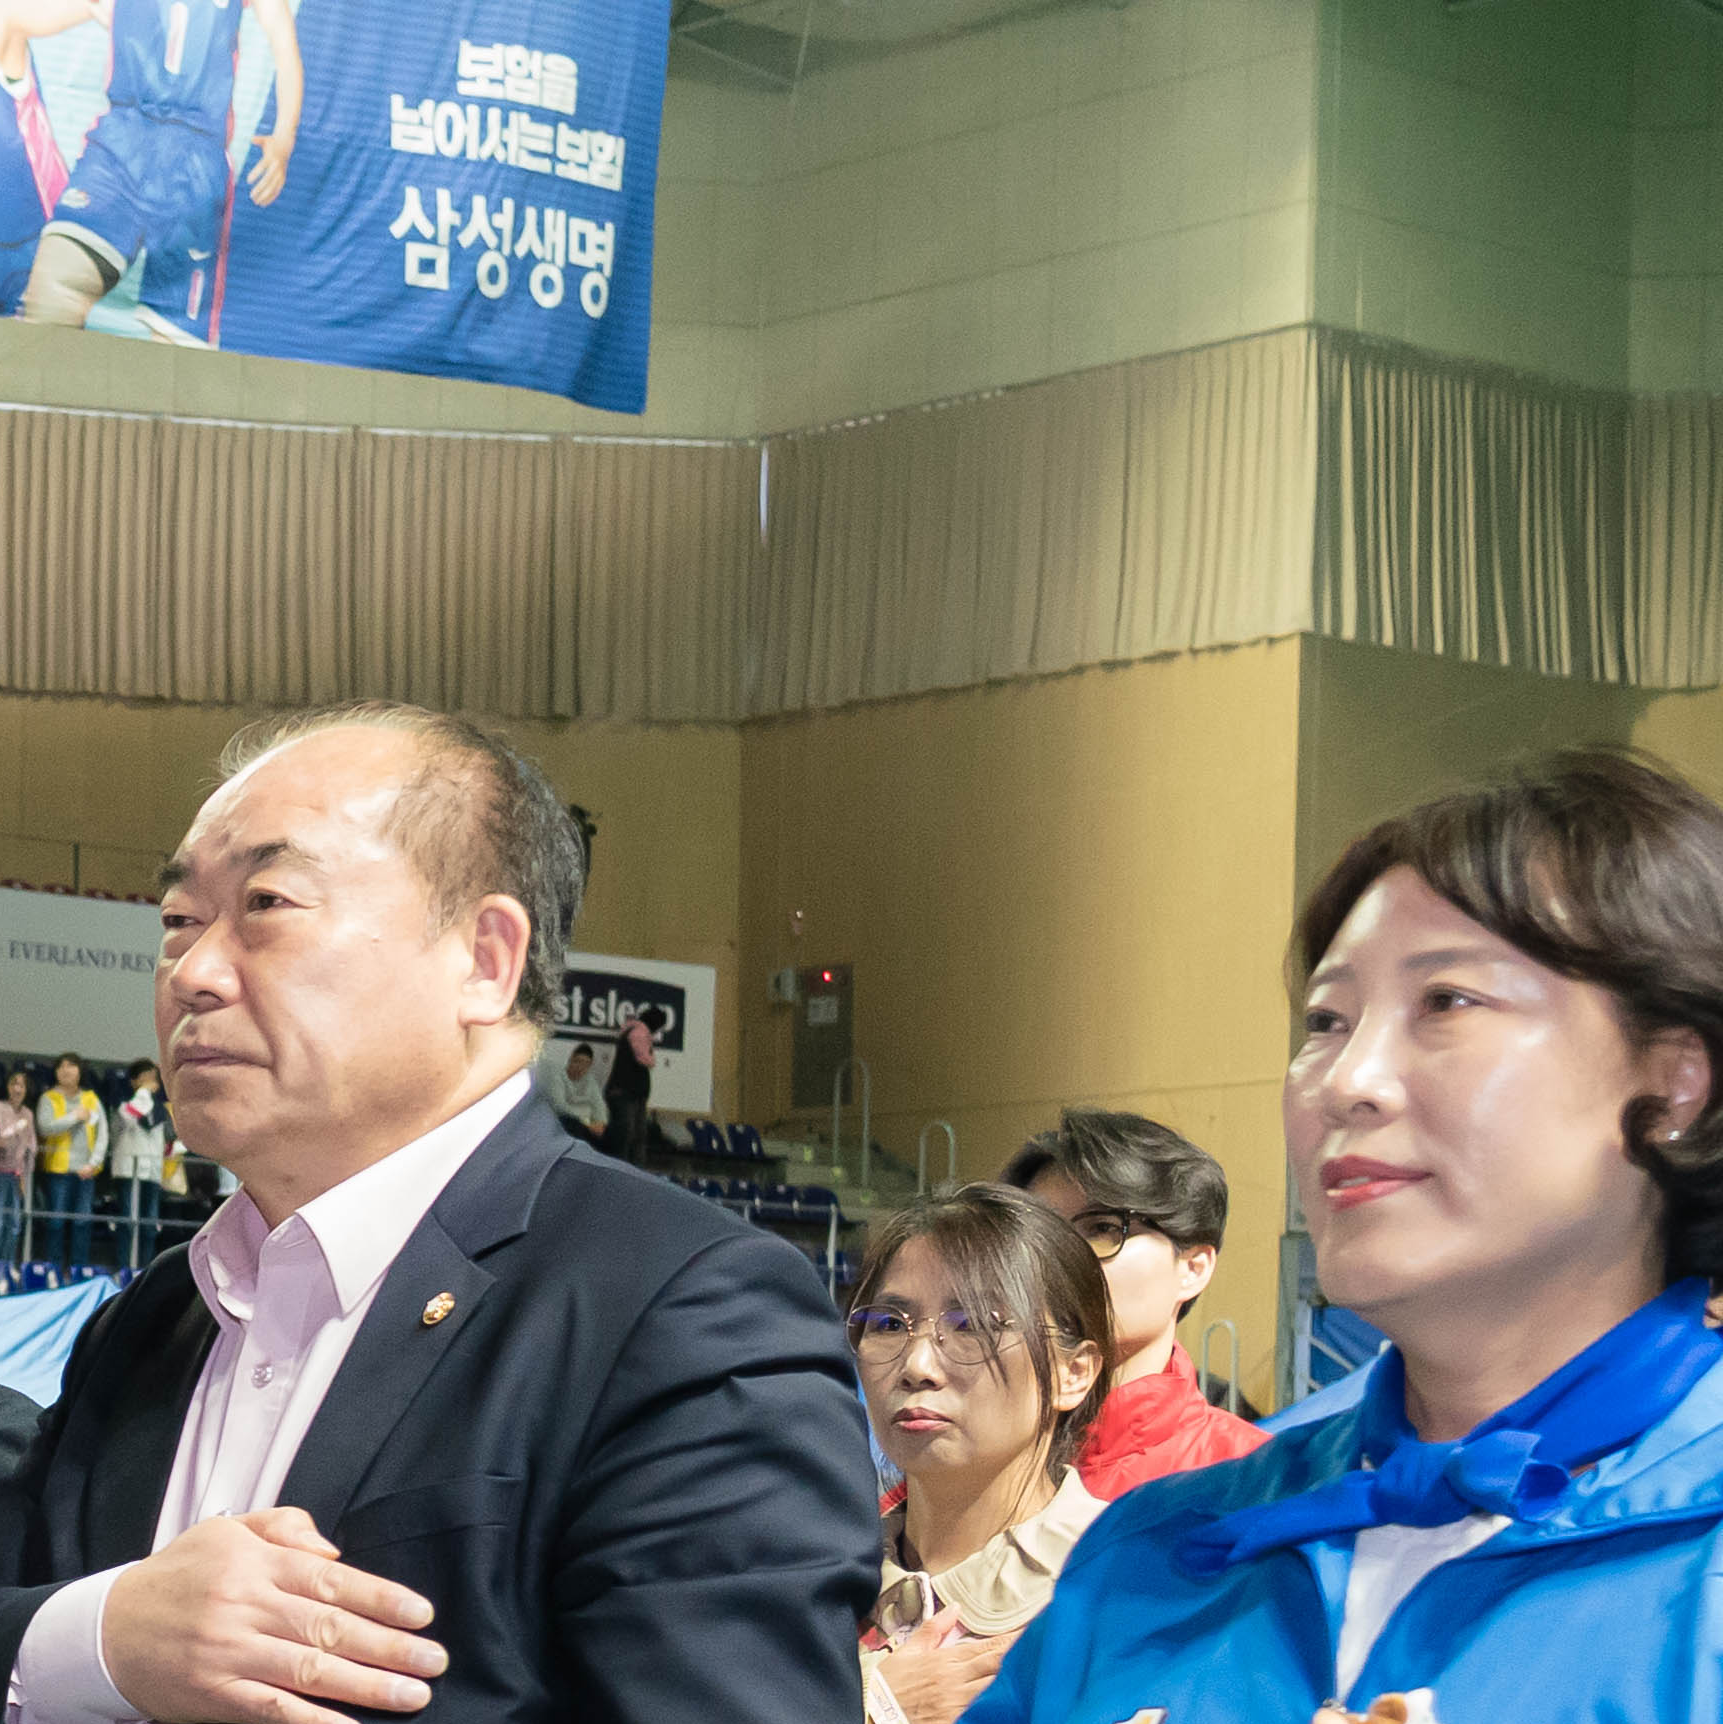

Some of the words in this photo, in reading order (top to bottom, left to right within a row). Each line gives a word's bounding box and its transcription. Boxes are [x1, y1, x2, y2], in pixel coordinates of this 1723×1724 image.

[457, 39, 578, 116] 보험을
[390, 93, 554, 174] 넘어서는
[555, 122, 625, 191] 보험
[389, 186, 615, 319] 삼성생명
[9, 939, 116, 969] EVERLAND
[552, 985, 583, 1025] st
